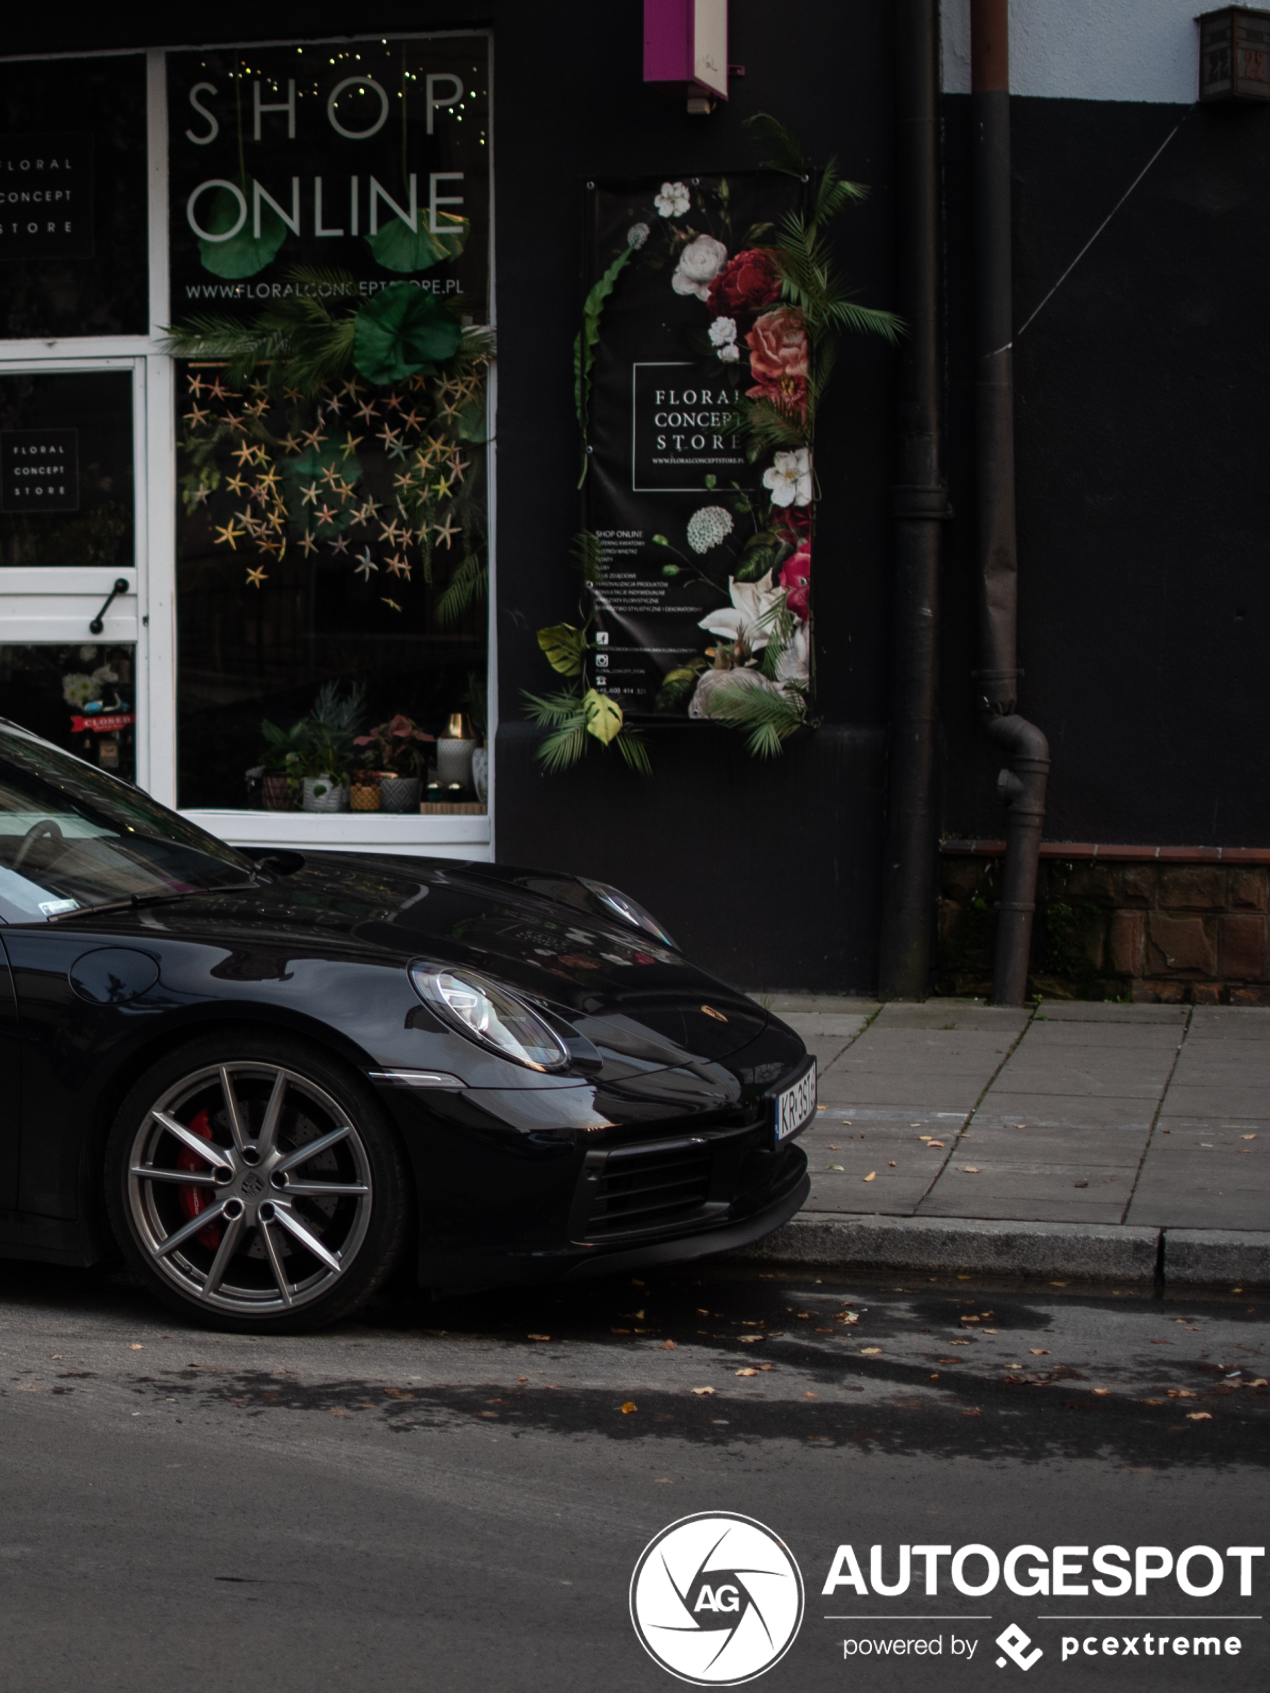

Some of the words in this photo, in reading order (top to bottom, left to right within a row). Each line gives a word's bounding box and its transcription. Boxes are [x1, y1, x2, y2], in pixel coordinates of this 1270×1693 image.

[185, 72, 465, 146] SHOP
[186, 172, 465, 243] ONLINE
[185, 279, 464, 299] WWW.FLORALCONCEPTRE.PL
[656, 434, 742, 450] STORE
[13, 446, 64, 454] FLORAL
[13, 466, 65, 476] CONCEPT
[14, 486, 65, 496] STORE
[595, 530, 615, 538] SHOP
[616, 530, 644, 539] ONLINE
[83, 716, 131, 728] CLOSED
[781, 1091, 796, 1134] KR
